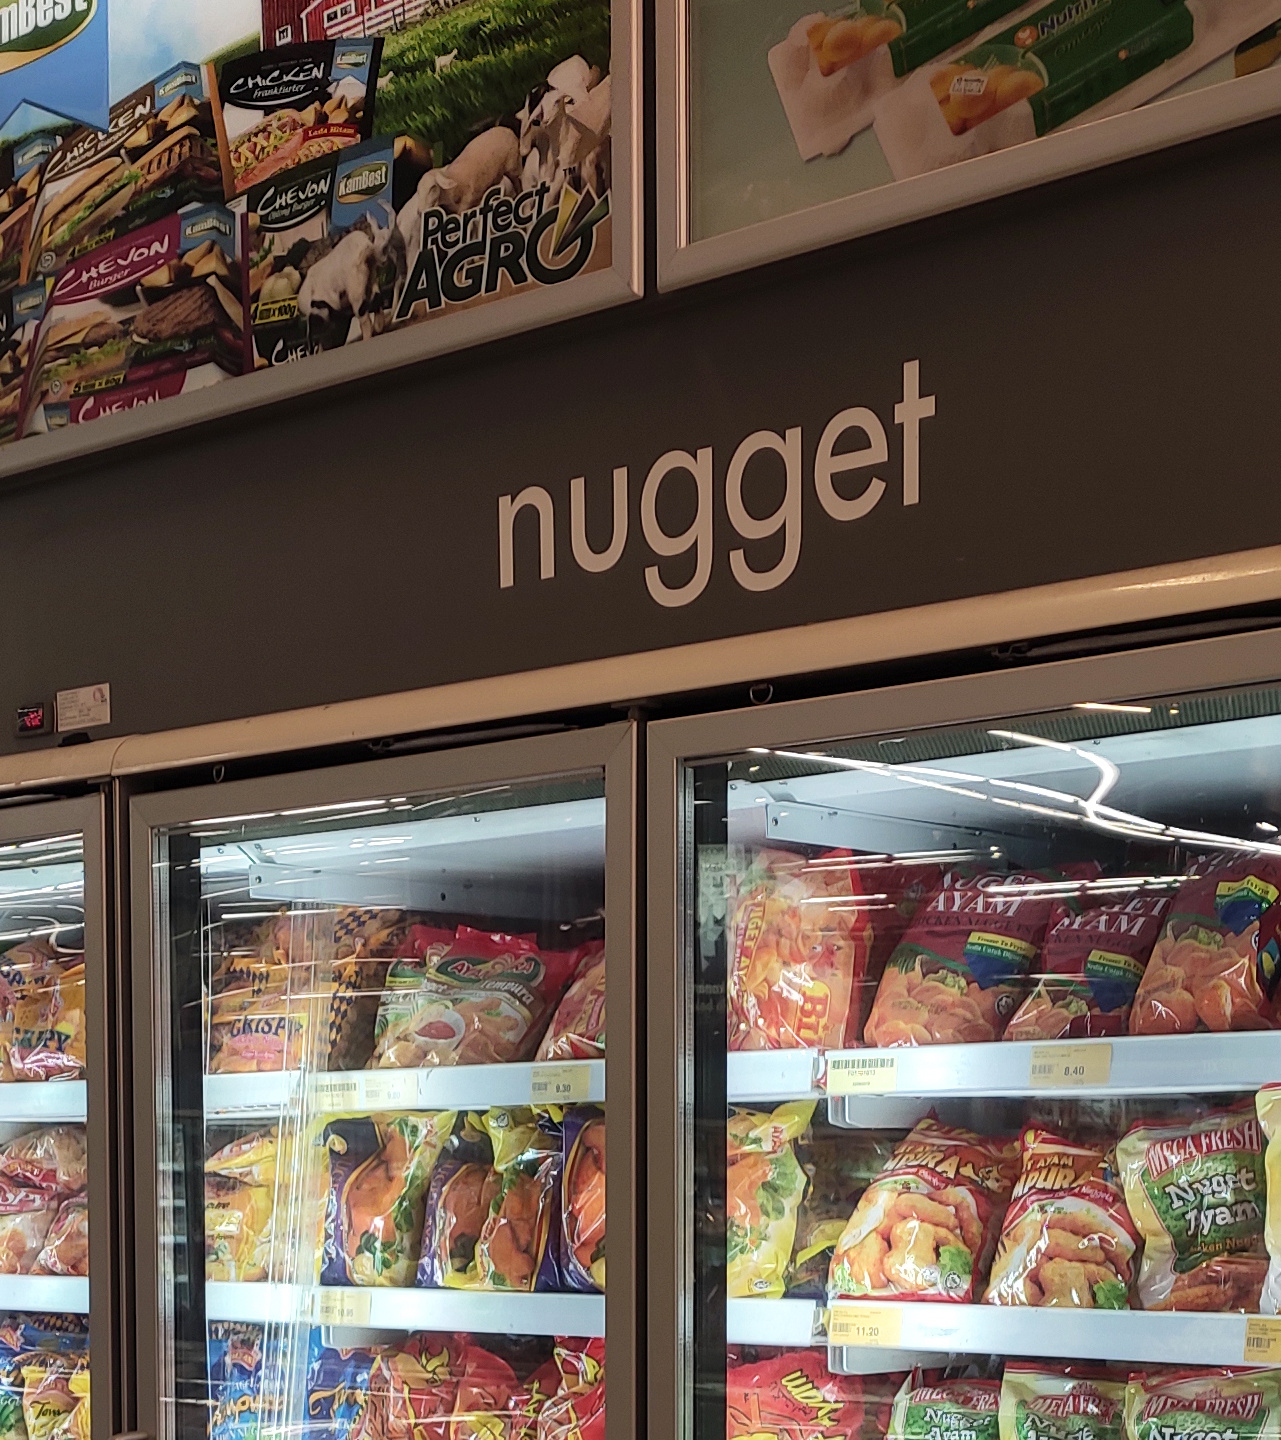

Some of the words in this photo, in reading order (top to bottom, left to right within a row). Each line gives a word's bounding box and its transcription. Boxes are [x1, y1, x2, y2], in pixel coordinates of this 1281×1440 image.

[257, 172, 332, 216] CHEVON
[338, 165, 388, 197] KamBest
[423, 180, 550, 252] Perfect
[53, 235, 169, 297] CHEVON
[89, 266, 131, 290] Burger
[395, 184, 611, 320] AGRO
[498, 359, 936, 608] nugget
[1147, 1136, 1196, 1180] MEGA
[1199, 1121, 1262, 1153] FRESH
